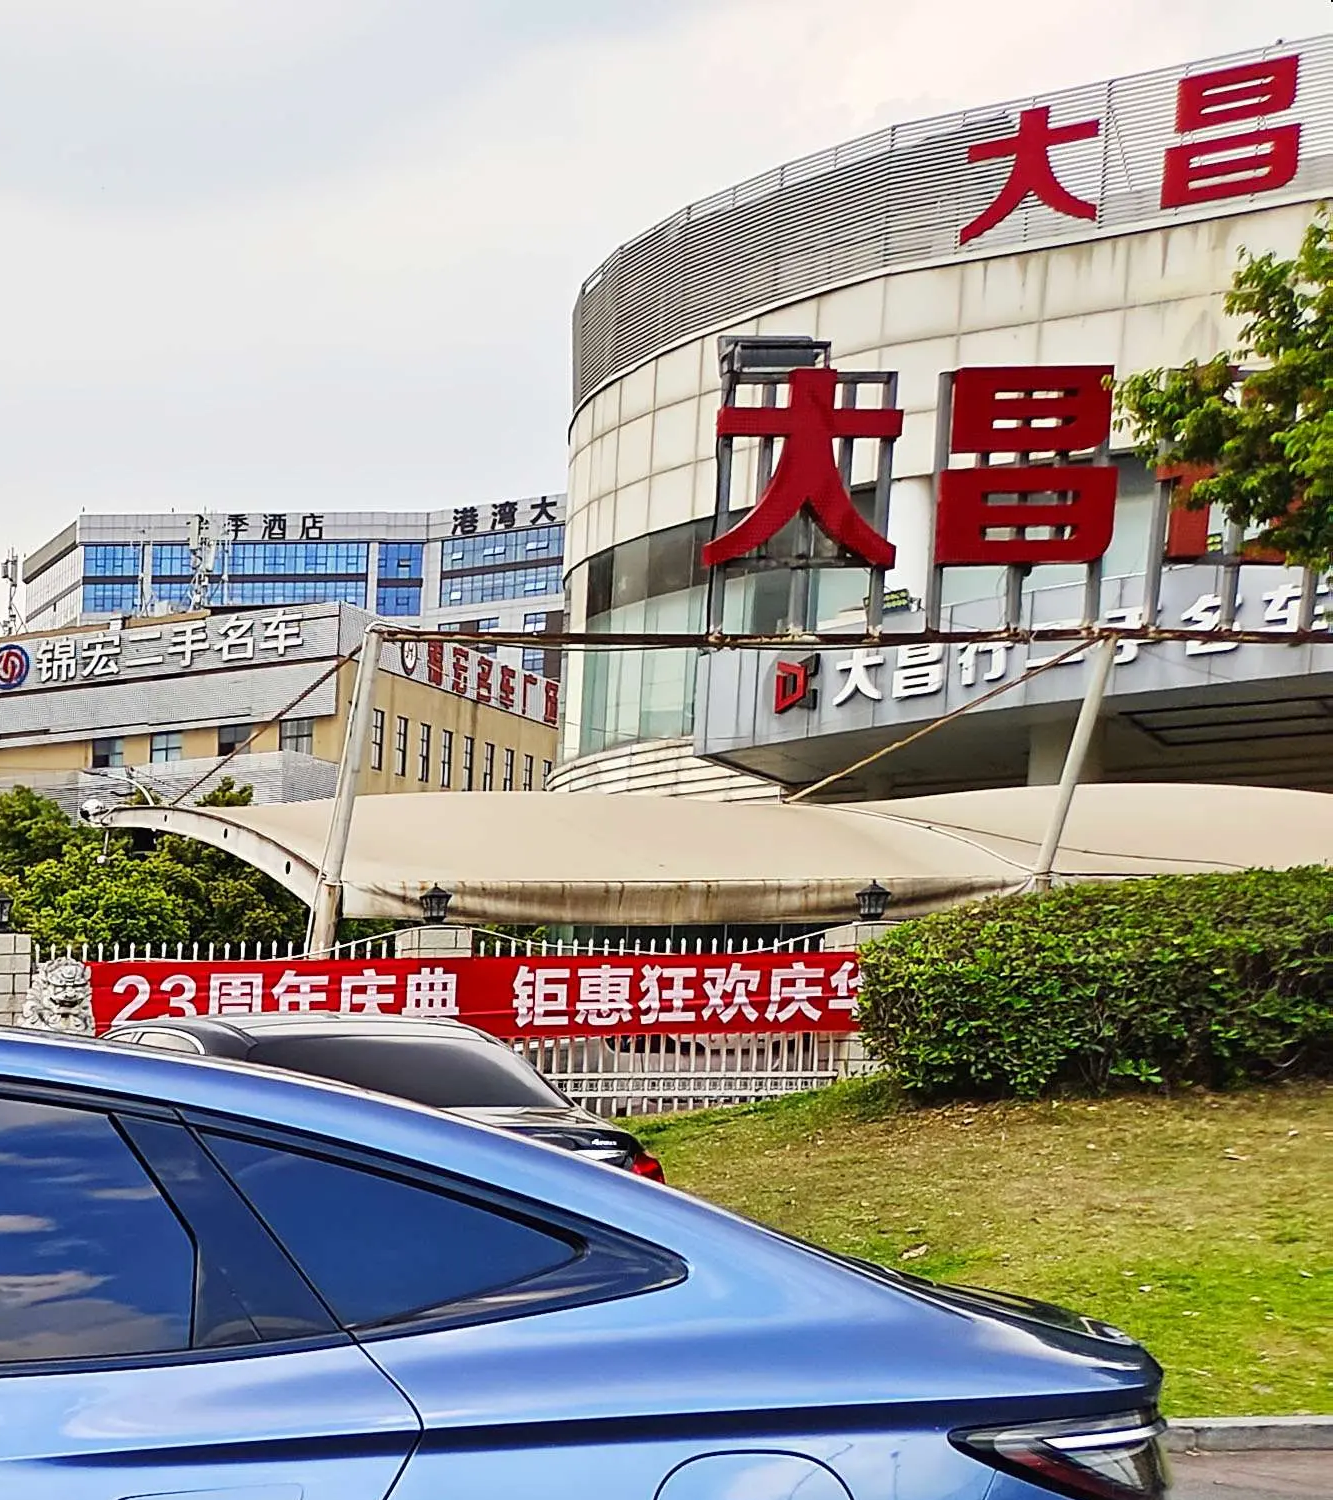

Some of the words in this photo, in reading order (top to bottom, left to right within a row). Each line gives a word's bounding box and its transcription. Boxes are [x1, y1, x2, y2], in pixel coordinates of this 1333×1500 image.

[959, 54, 1301, 246] 大昌
[450, 496, 558, 536] 港湾大
[36, 610, 304, 683] 锦宏二手名车
[111, 968, 460, 1026] 23周年庆典
